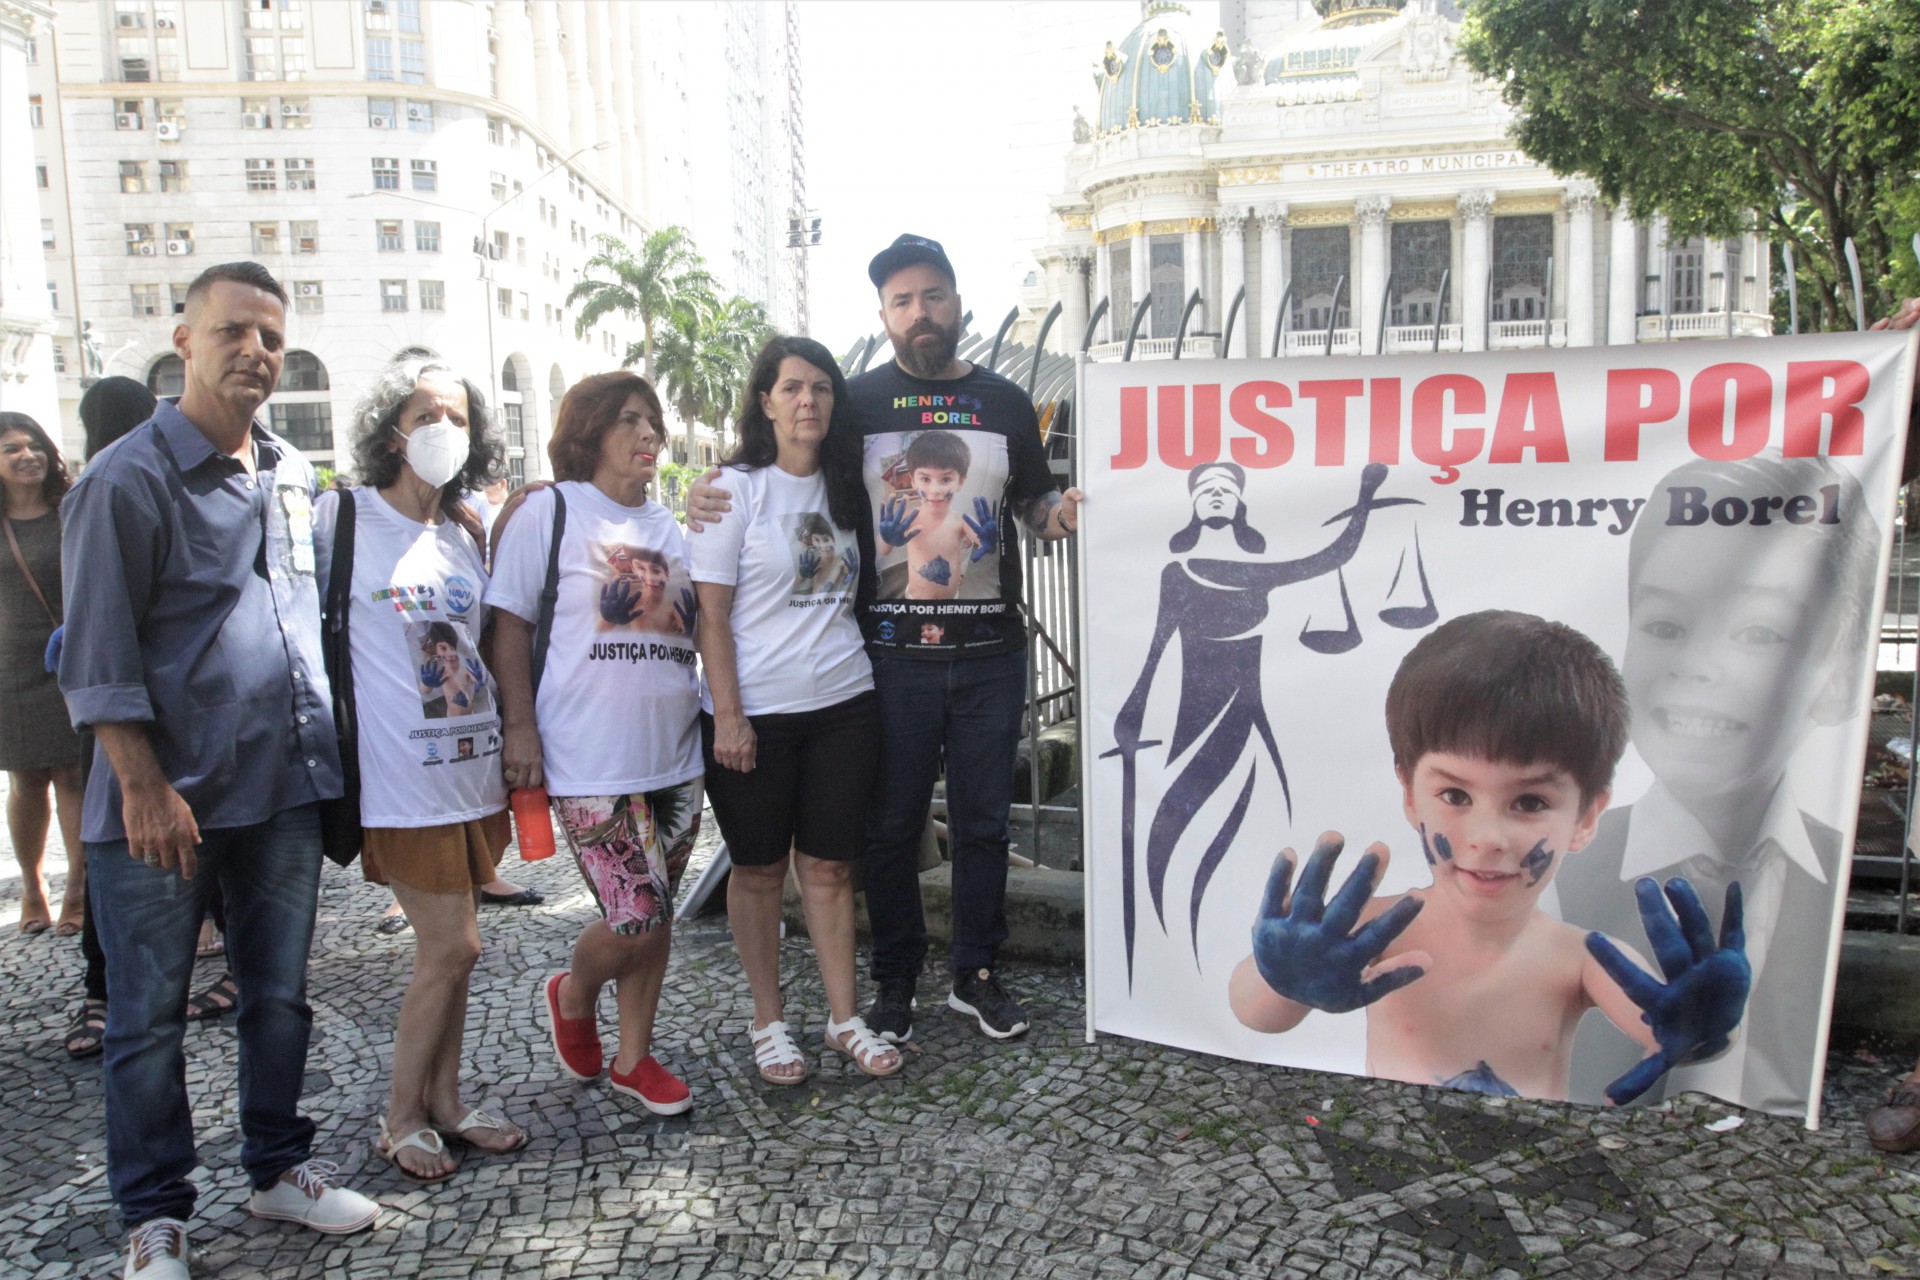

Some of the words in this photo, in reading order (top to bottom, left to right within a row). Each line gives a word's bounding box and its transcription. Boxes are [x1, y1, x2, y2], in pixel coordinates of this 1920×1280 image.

[1320, 160, 1409, 177] THEATRO
[893, 395, 956, 408] HENRY
[921, 411, 981, 425] BOREL
[1110, 371, 1569, 484] JUSTIÇA
[1603, 359, 1872, 462] POR
[1458, 486, 1647, 536] Henry
[1664, 484, 1842, 527] Borel
[823, 597, 837, 605] OR
[909, 604, 934, 614] POR
[936, 605, 979, 615] HENRY
[589, 642, 647, 664] JUSTIÇA
[408, 727, 450, 740] JUSTIÇA
[449, 725, 467, 736] POR
